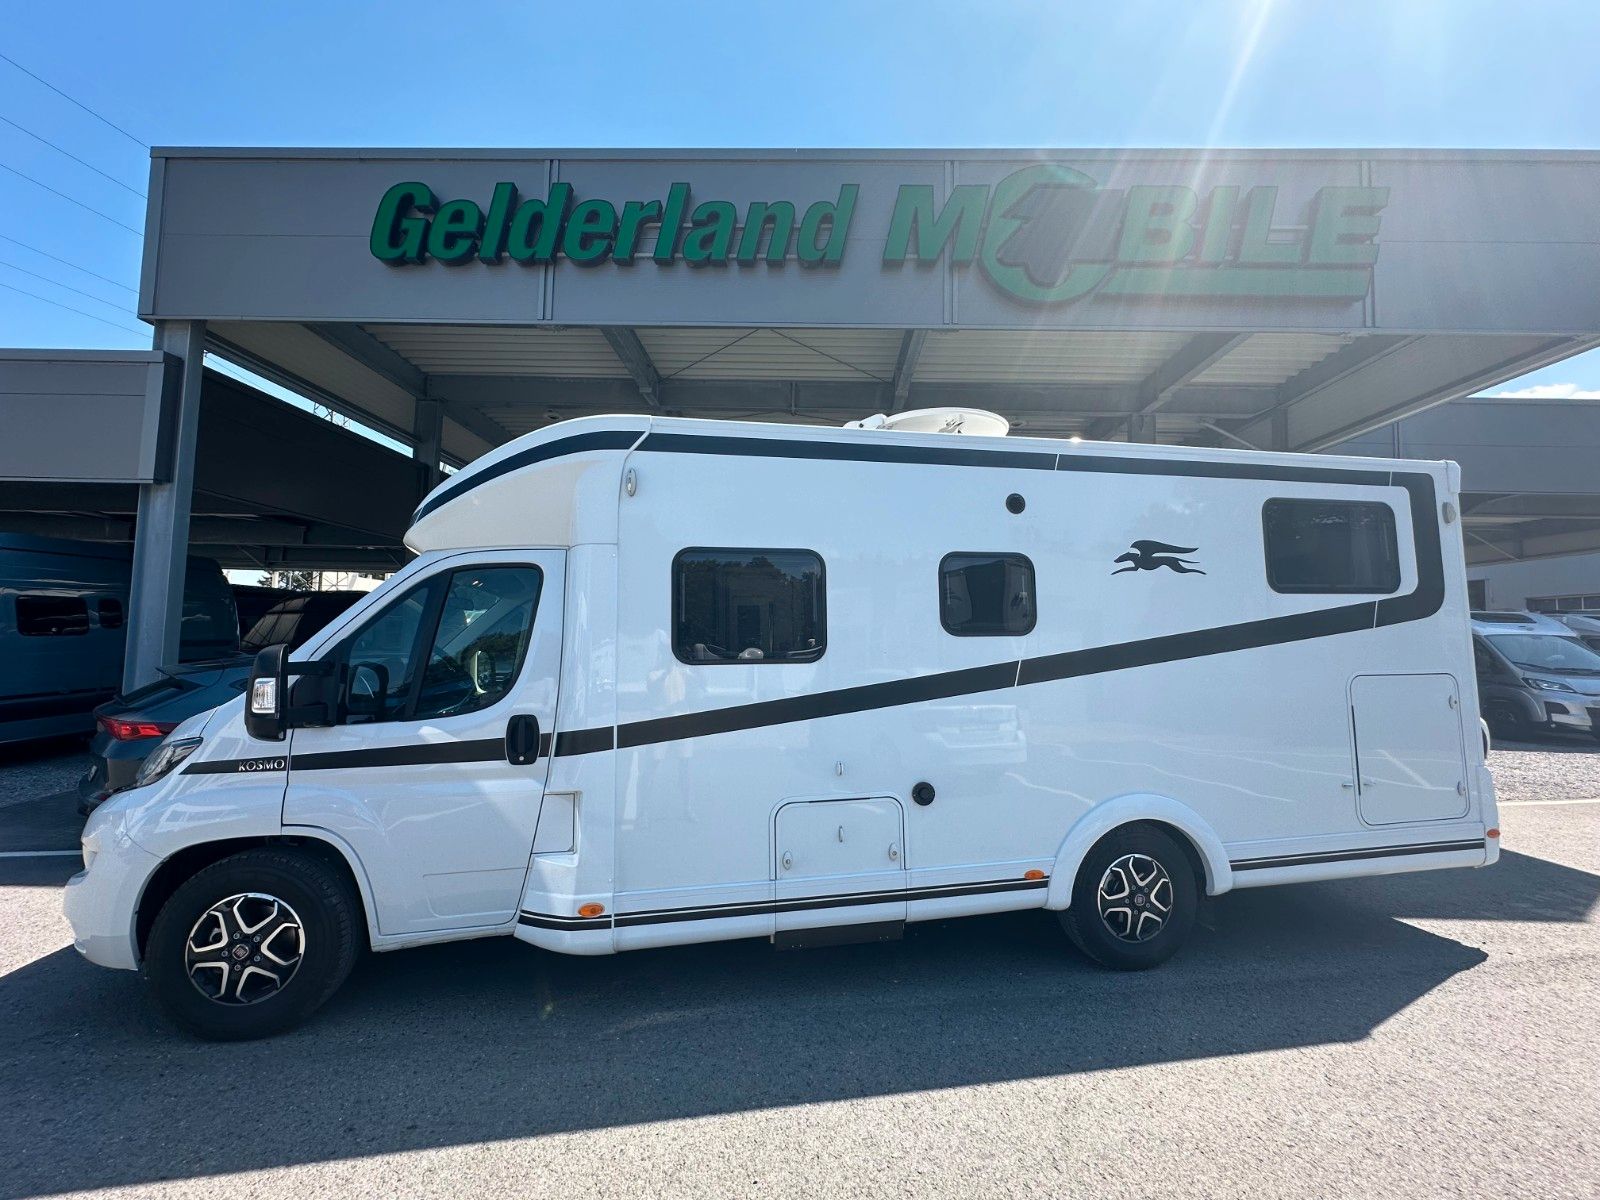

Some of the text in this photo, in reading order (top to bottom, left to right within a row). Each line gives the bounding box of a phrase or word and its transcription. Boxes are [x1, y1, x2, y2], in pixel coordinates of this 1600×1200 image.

[369, 164, 1390, 305] Gelderland MOBILE
[238, 759, 285, 771] KOSMO
